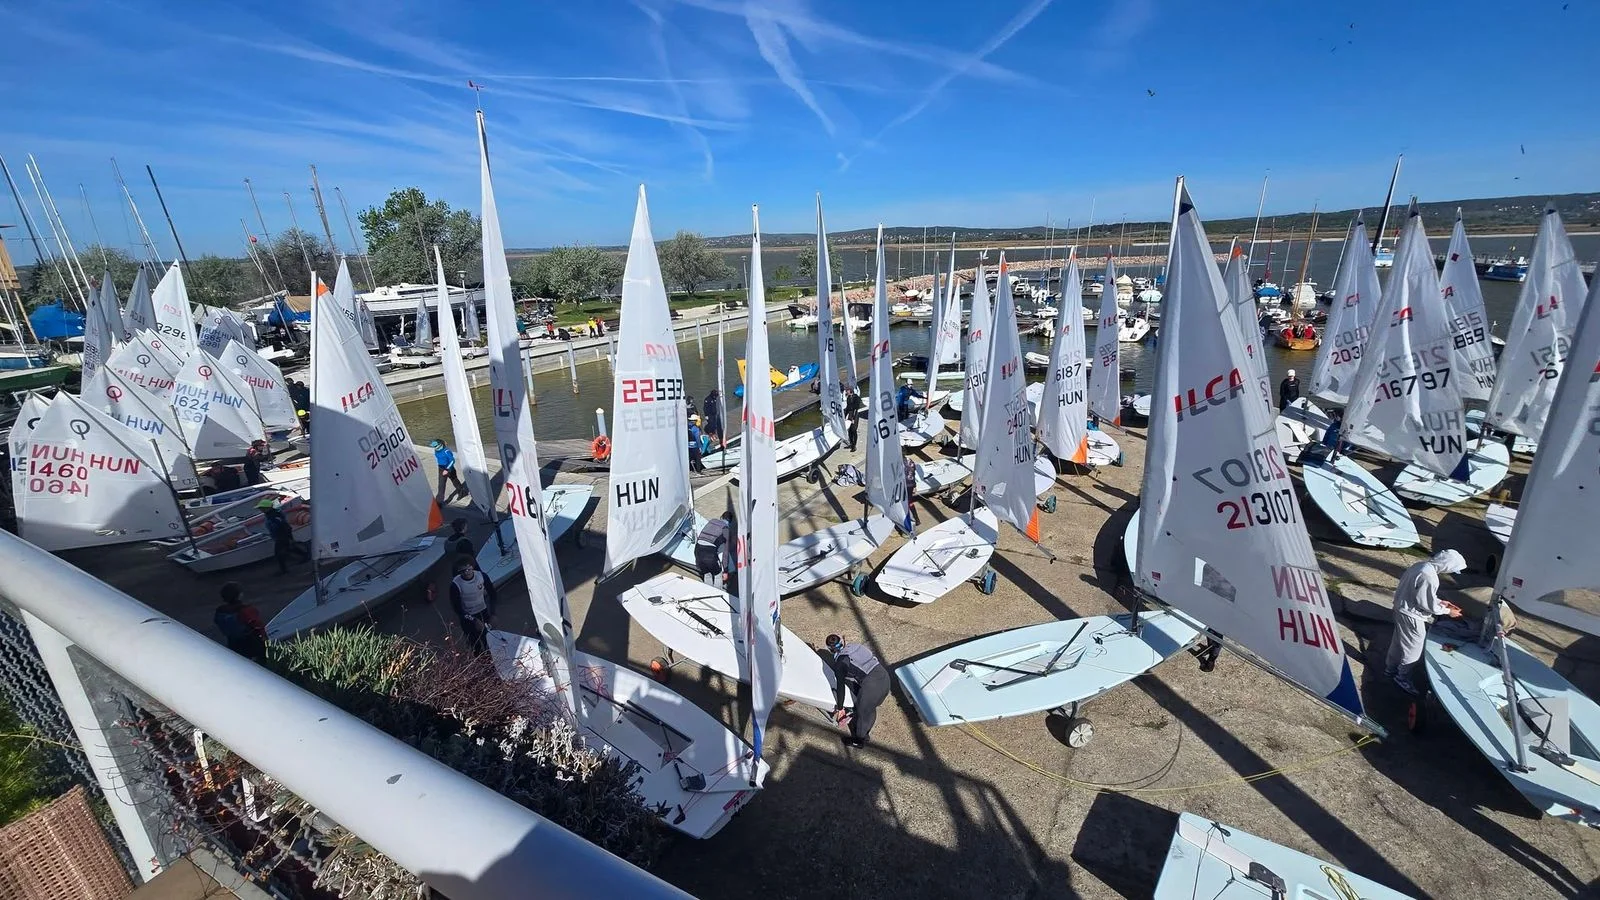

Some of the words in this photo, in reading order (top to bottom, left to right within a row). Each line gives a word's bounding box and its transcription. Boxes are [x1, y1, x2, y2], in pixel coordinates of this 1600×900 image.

[342, 382, 375, 414] ILCA
[622, 378, 685, 403] 22533
[1174, 367, 1246, 422] ILCA
[1375, 367, 1450, 402] 16797
[174, 395, 210, 413] 1624
[212, 391, 243, 409] HUN
[1058, 390, 1083, 407] HUN
[126, 415, 164, 435] HUN
[30, 460, 88, 480] 1460
[90, 454, 141, 474] HUN
[392, 455, 418, 486] HUN
[616, 477, 659, 507] HUN
[1217, 488, 1297, 530] 213107
[1278, 607, 1340, 655] HUN
